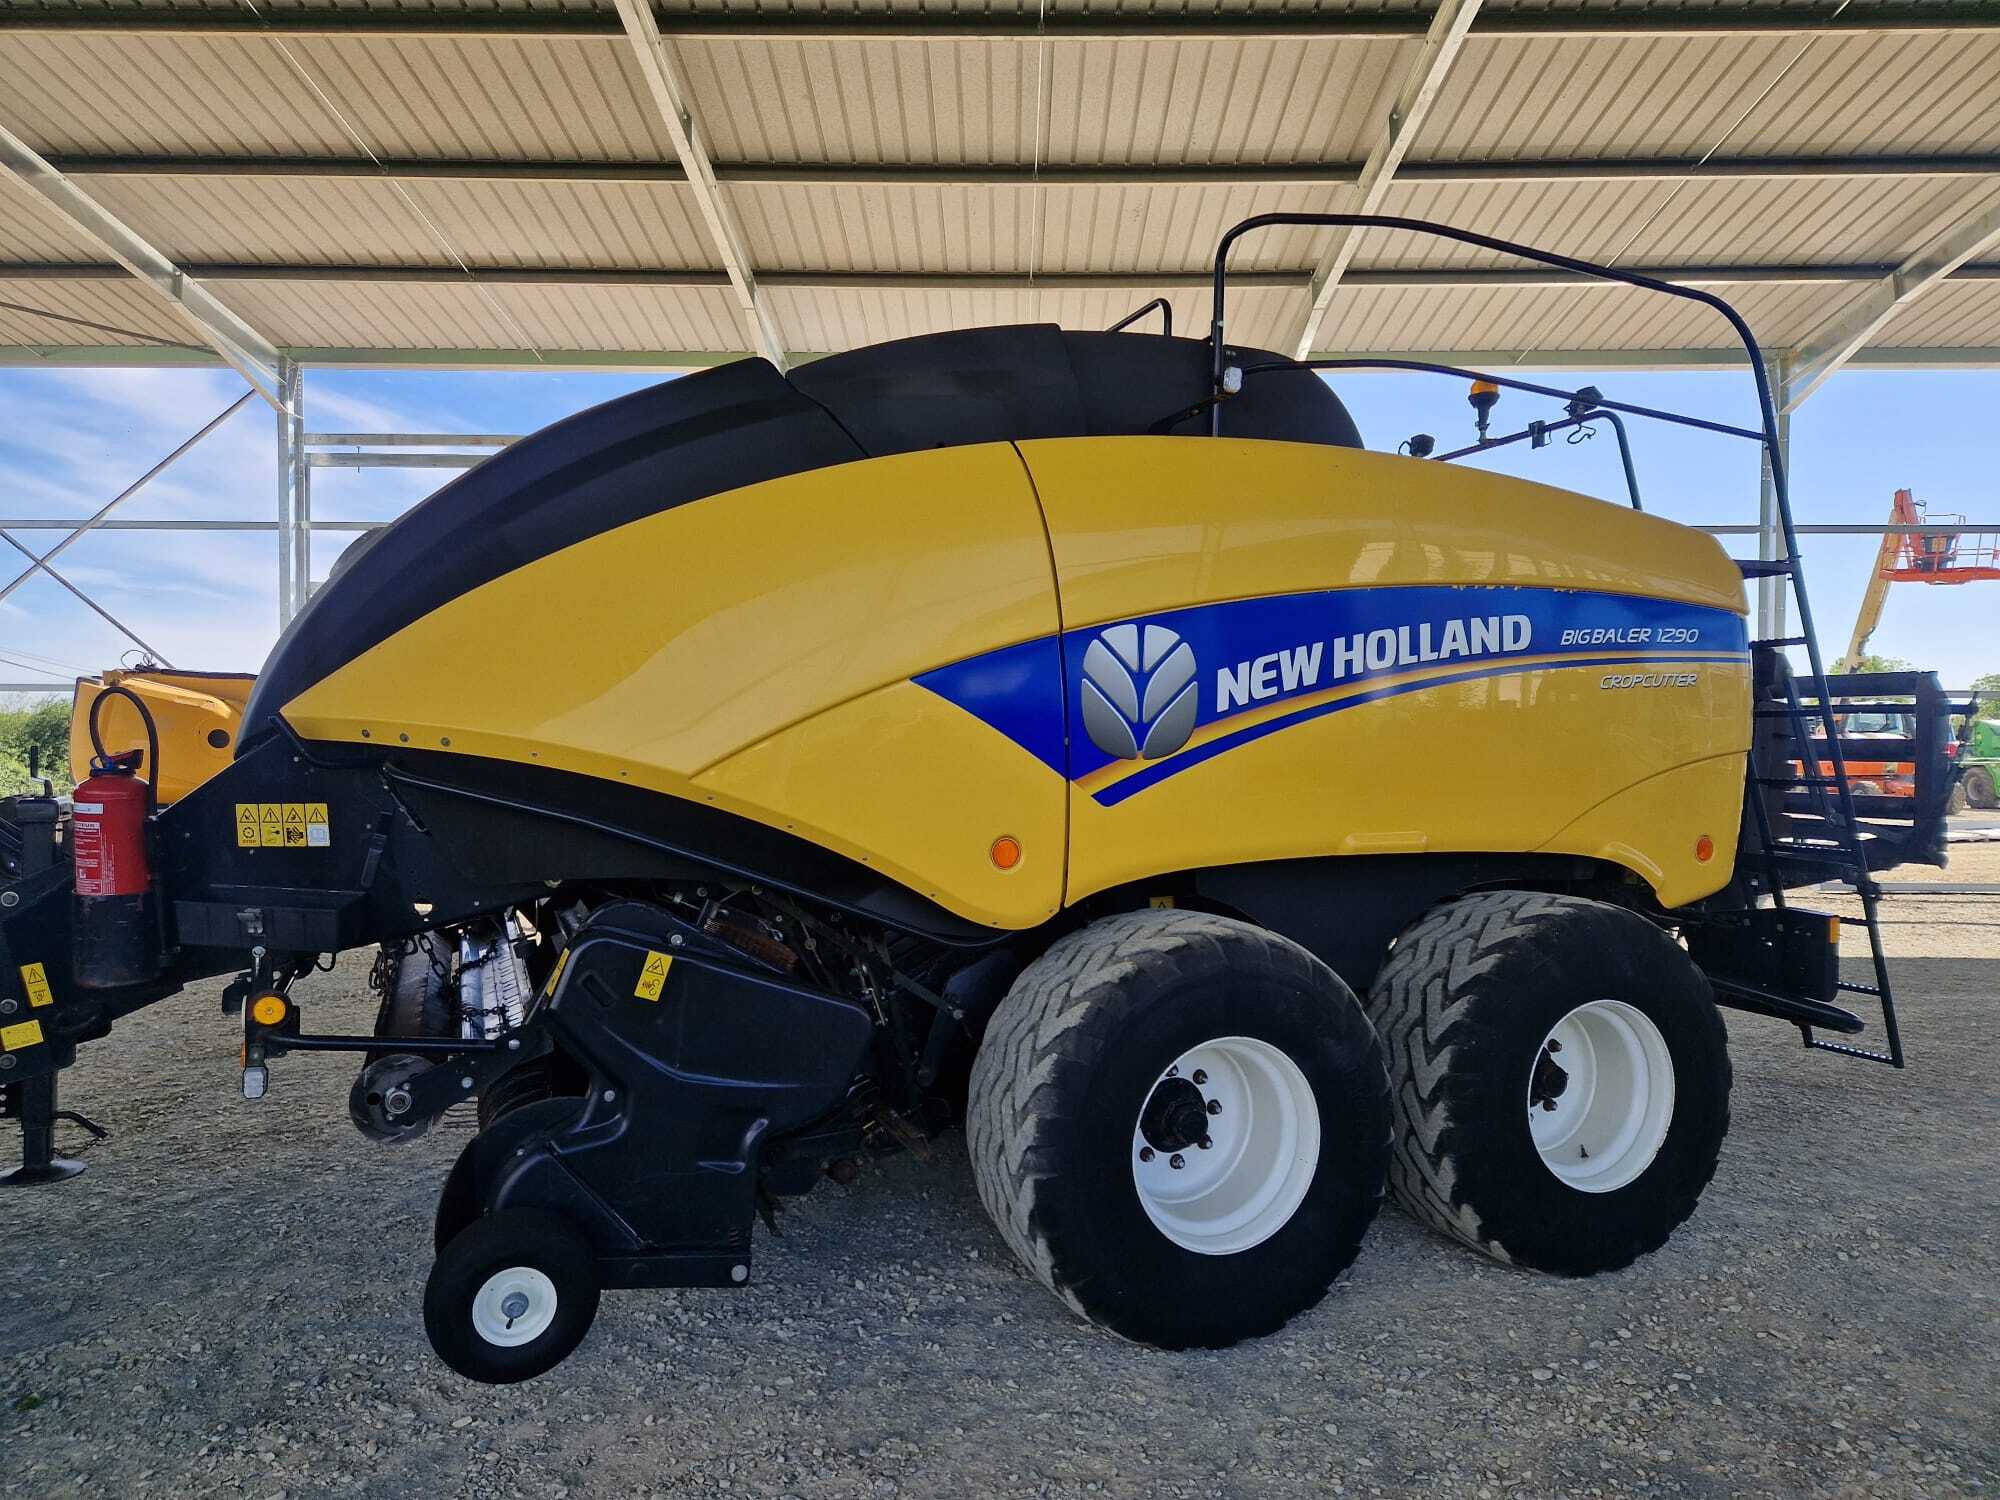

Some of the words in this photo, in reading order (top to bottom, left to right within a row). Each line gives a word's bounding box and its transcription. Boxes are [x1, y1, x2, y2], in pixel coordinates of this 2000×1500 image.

[1560, 628, 1652, 645] BIGBALER
[1657, 628, 1699, 643] 1290
[1216, 642, 1324, 712] NEW
[1333, 614, 1532, 679] HOLLAND
[1600, 673, 1698, 689] CROPCUTTER
